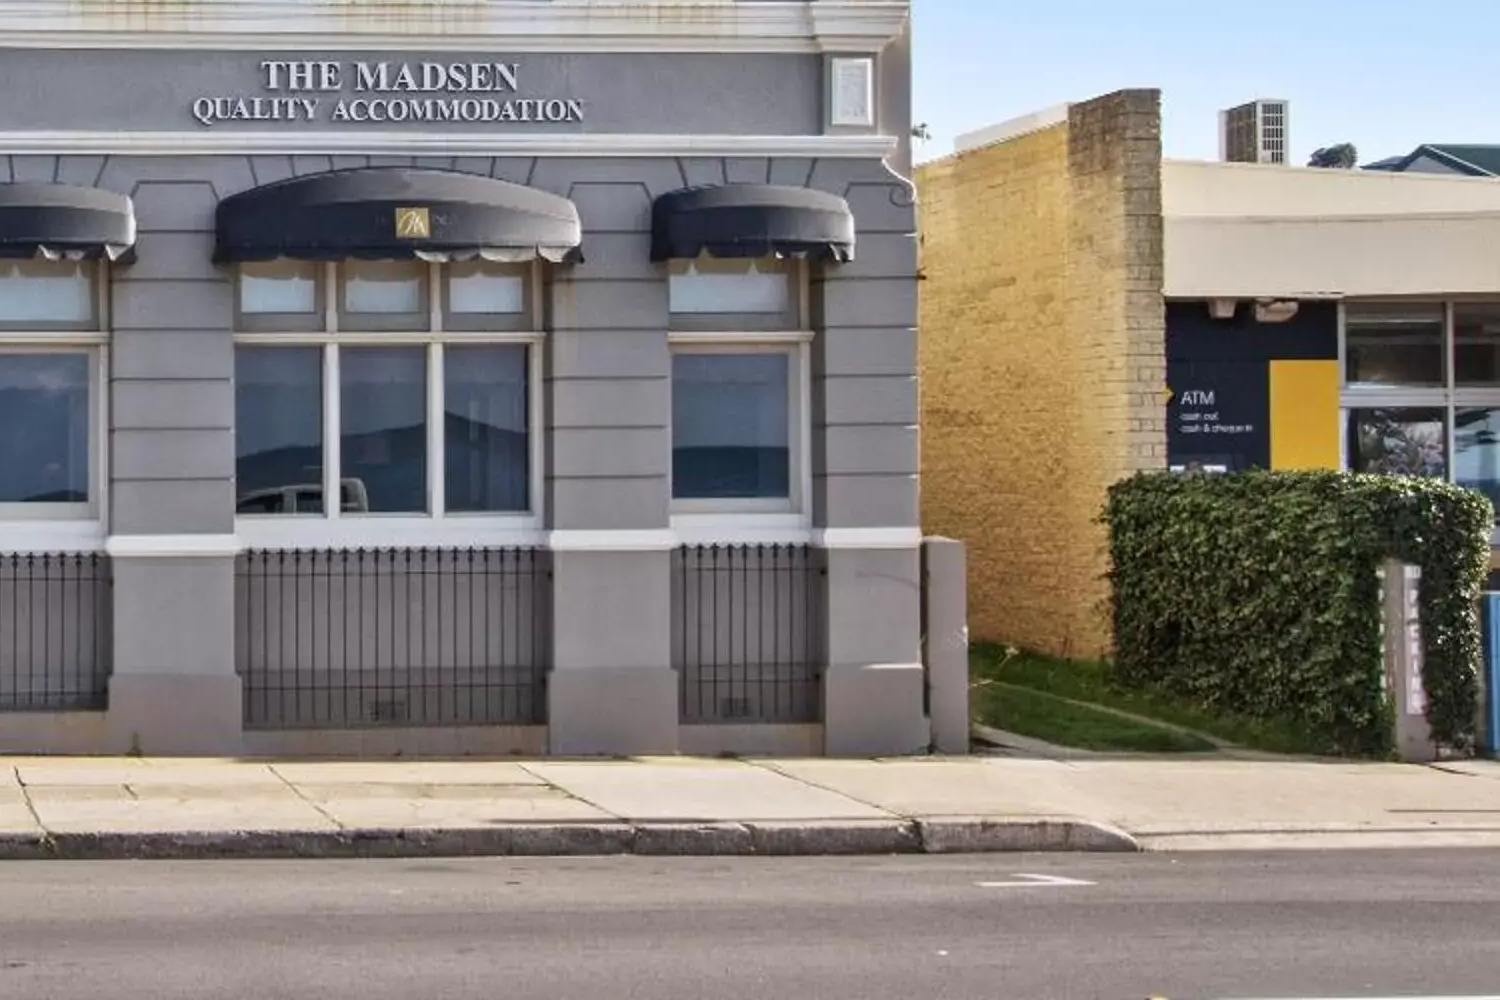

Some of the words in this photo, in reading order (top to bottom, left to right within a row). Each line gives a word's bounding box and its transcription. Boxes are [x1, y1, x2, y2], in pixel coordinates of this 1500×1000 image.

[260, 60, 343, 91] THE
[353, 60, 520, 92] MADSEN
[192, 97, 319, 126] QUALITY
[330, 98, 585, 123] ACCOMMODATION
[1180, 391, 1215, 406] ATM
